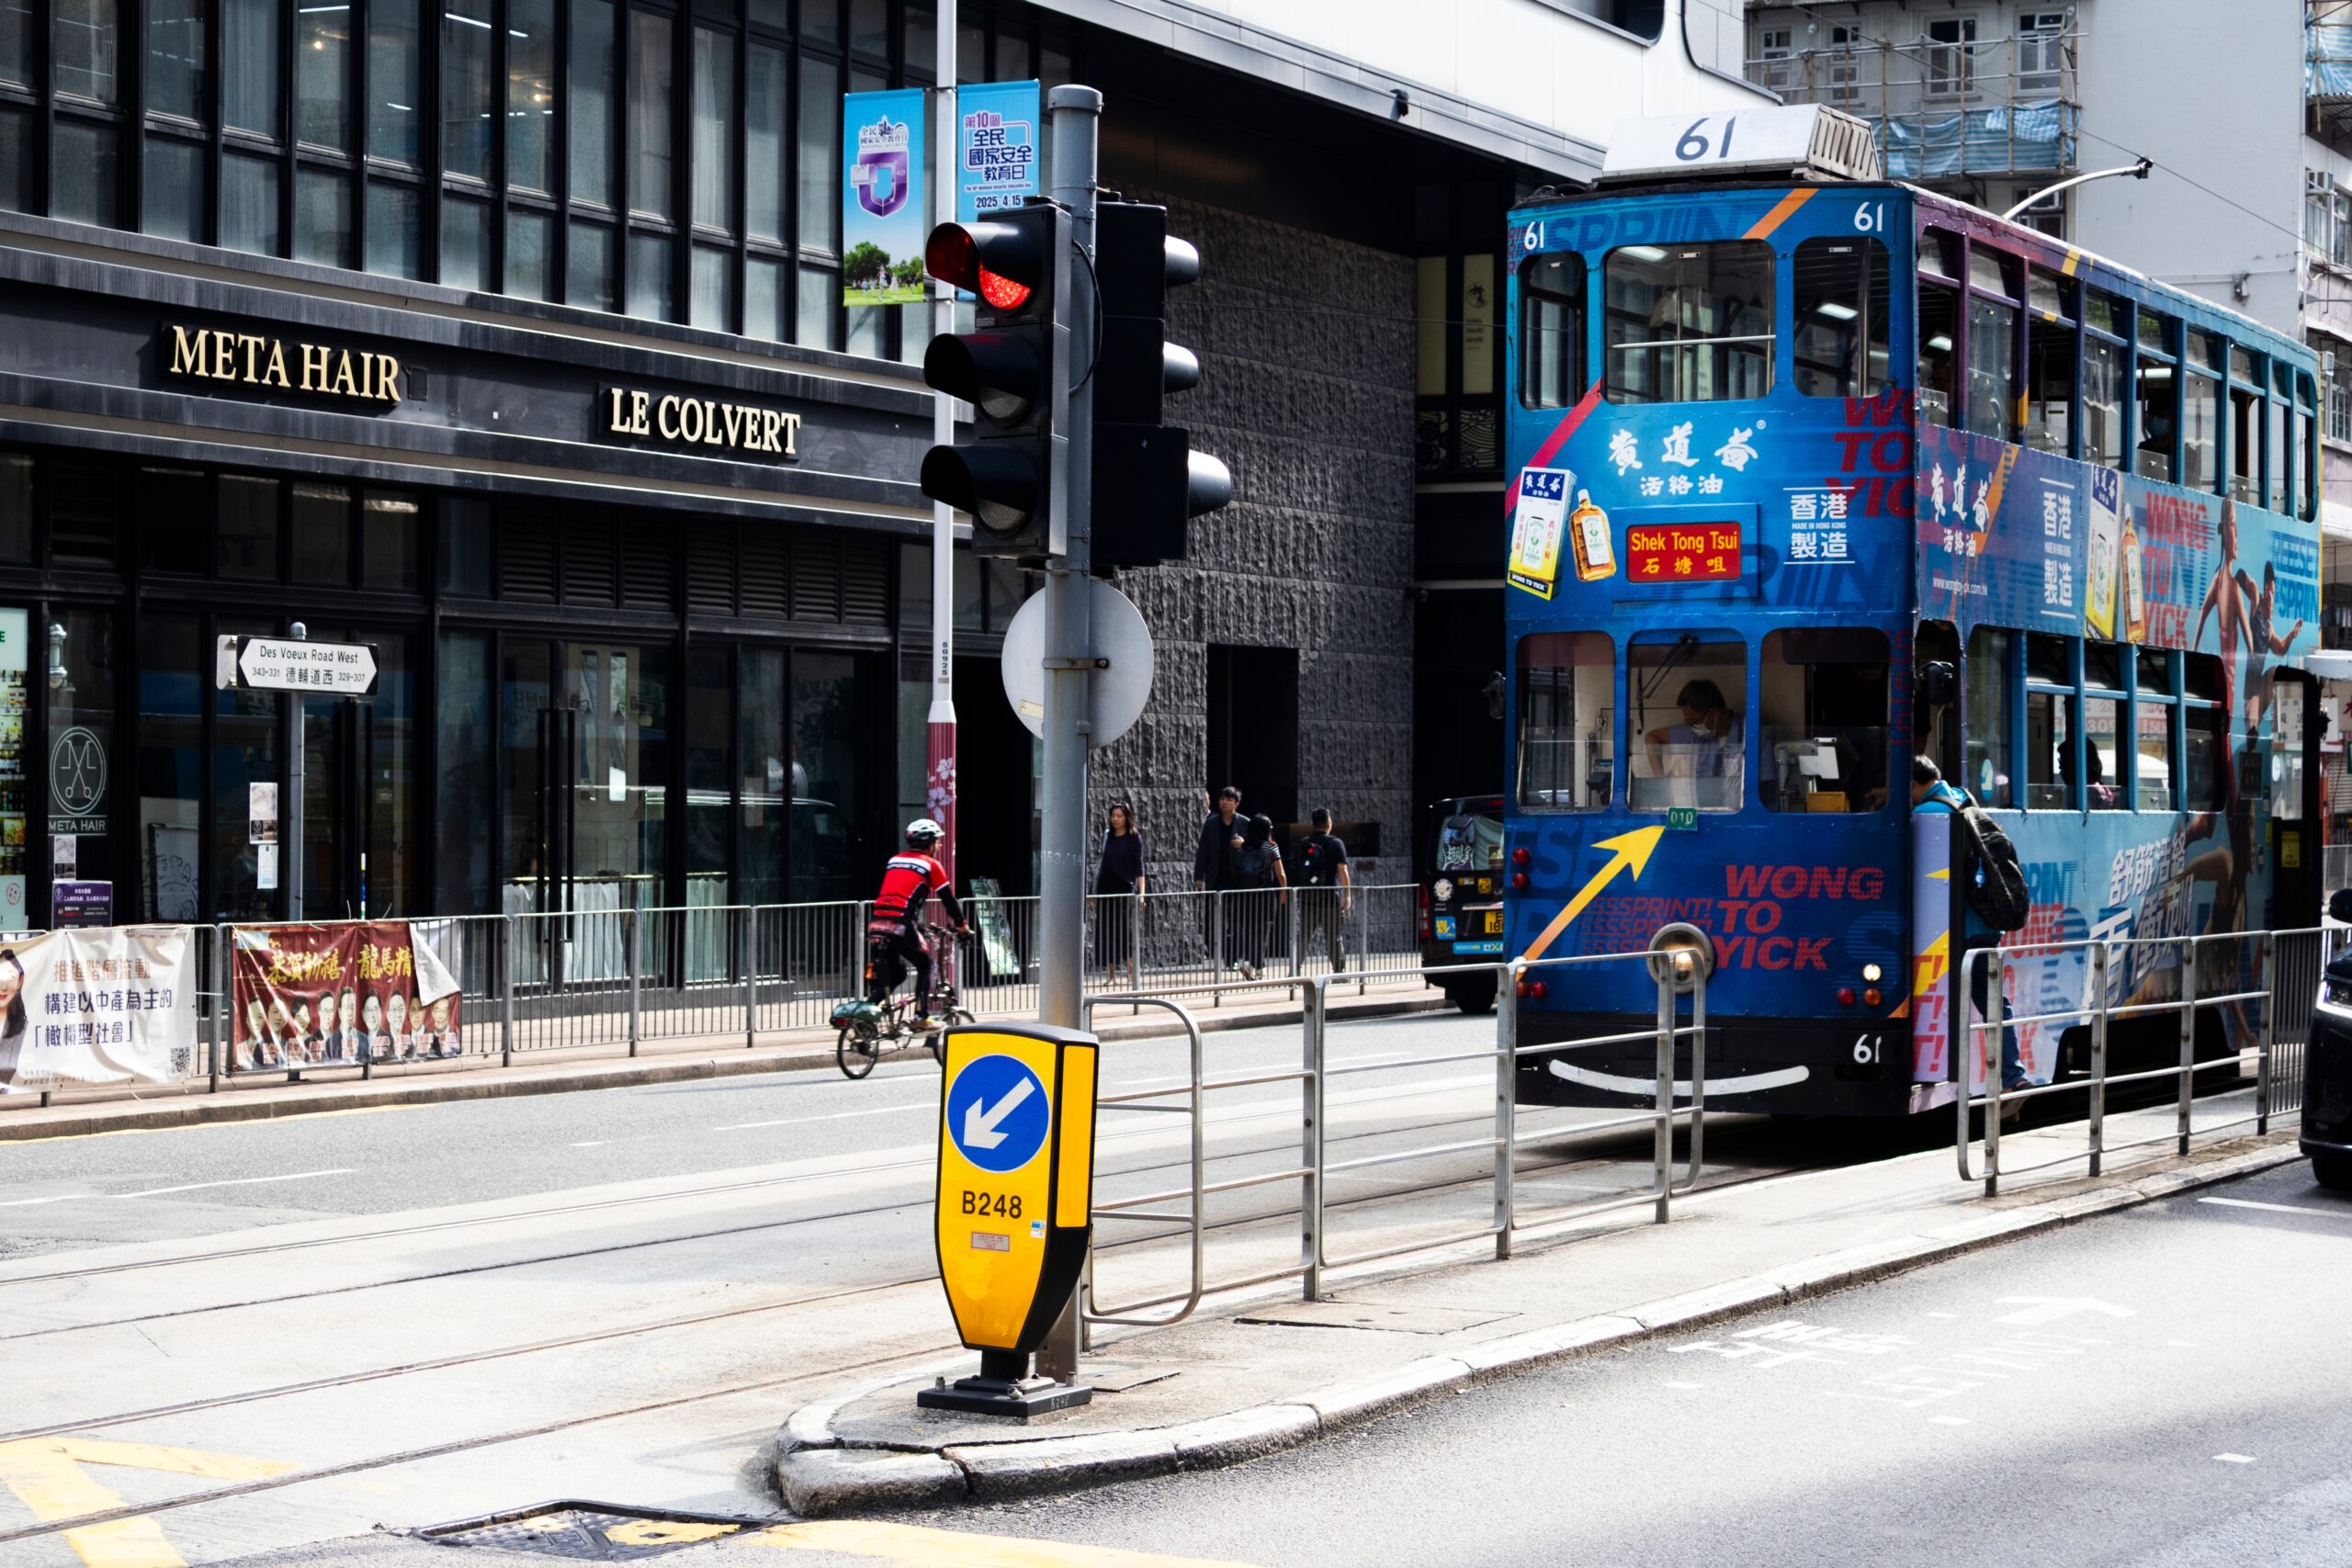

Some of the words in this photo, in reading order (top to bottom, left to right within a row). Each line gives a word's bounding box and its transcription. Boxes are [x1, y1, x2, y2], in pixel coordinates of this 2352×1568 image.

[965, 112, 1001, 129] 第10個
[974, 129, 1005, 147] 全民
[1676, 117, 1736, 161] 61
[969, 145, 1032, 166] 國家安全
[984, 165, 1025, 181] 教育日
[1854, 202, 1883, 231] 61
[1524, 220, 1544, 250] 61
[170, 325, 291, 388] META
[300, 344, 401, 402] HAIR
[611, 388, 650, 435] LE
[658, 395, 800, 454] COLVERT
[1640, 473, 1724, 496] 活絡油
[1791, 493, 1849, 520] 香港
[2043, 491, 2072, 540] 香港
[2146, 491, 2209, 550] WONG
[1815, 522, 1830, 530] HONG
[1831, 522, 1847, 530] KONG
[1631, 532, 1667, 551] Shek
[1671, 531, 1704, 554] Tong
[1710, 530, 1738, 549] Tsui
[1791, 532, 1849, 558] 製造
[1641, 556, 1727, 575] 石塘咀
[2144, 545, 2170, 596] TO
[2044, 558, 2073, 607] 製造
[260, 645, 277, 658] Des
[280, 647, 308, 660] Voeux
[311, 649, 334, 662] Road
[337, 651, 358, 664] West
[286, 667, 333, 685] 德輔道西
[49, 820, 77, 832] META
[81, 820, 106, 831] HAIR
[1670, 810, 1694, 828] 010
[1725, 864, 1885, 900] WONG
[2109, 831, 2187, 908] 舒筋活絡
[1717, 900, 1783, 933] TO
[266, 948, 343, 986] 恭賀新禧
[357, 943, 413, 980] 龍馬精
[1714, 935, 1835, 971] YICK
[54, 958, 151, 983] 推進階層流動
[45, 987, 173, 1015] 構建以中產為主的
[35, 1021, 133, 1048] 「橄欖型社會」
[1853, 1033, 1882, 1064] 61
[962, 1190, 1022, 1219] B248
